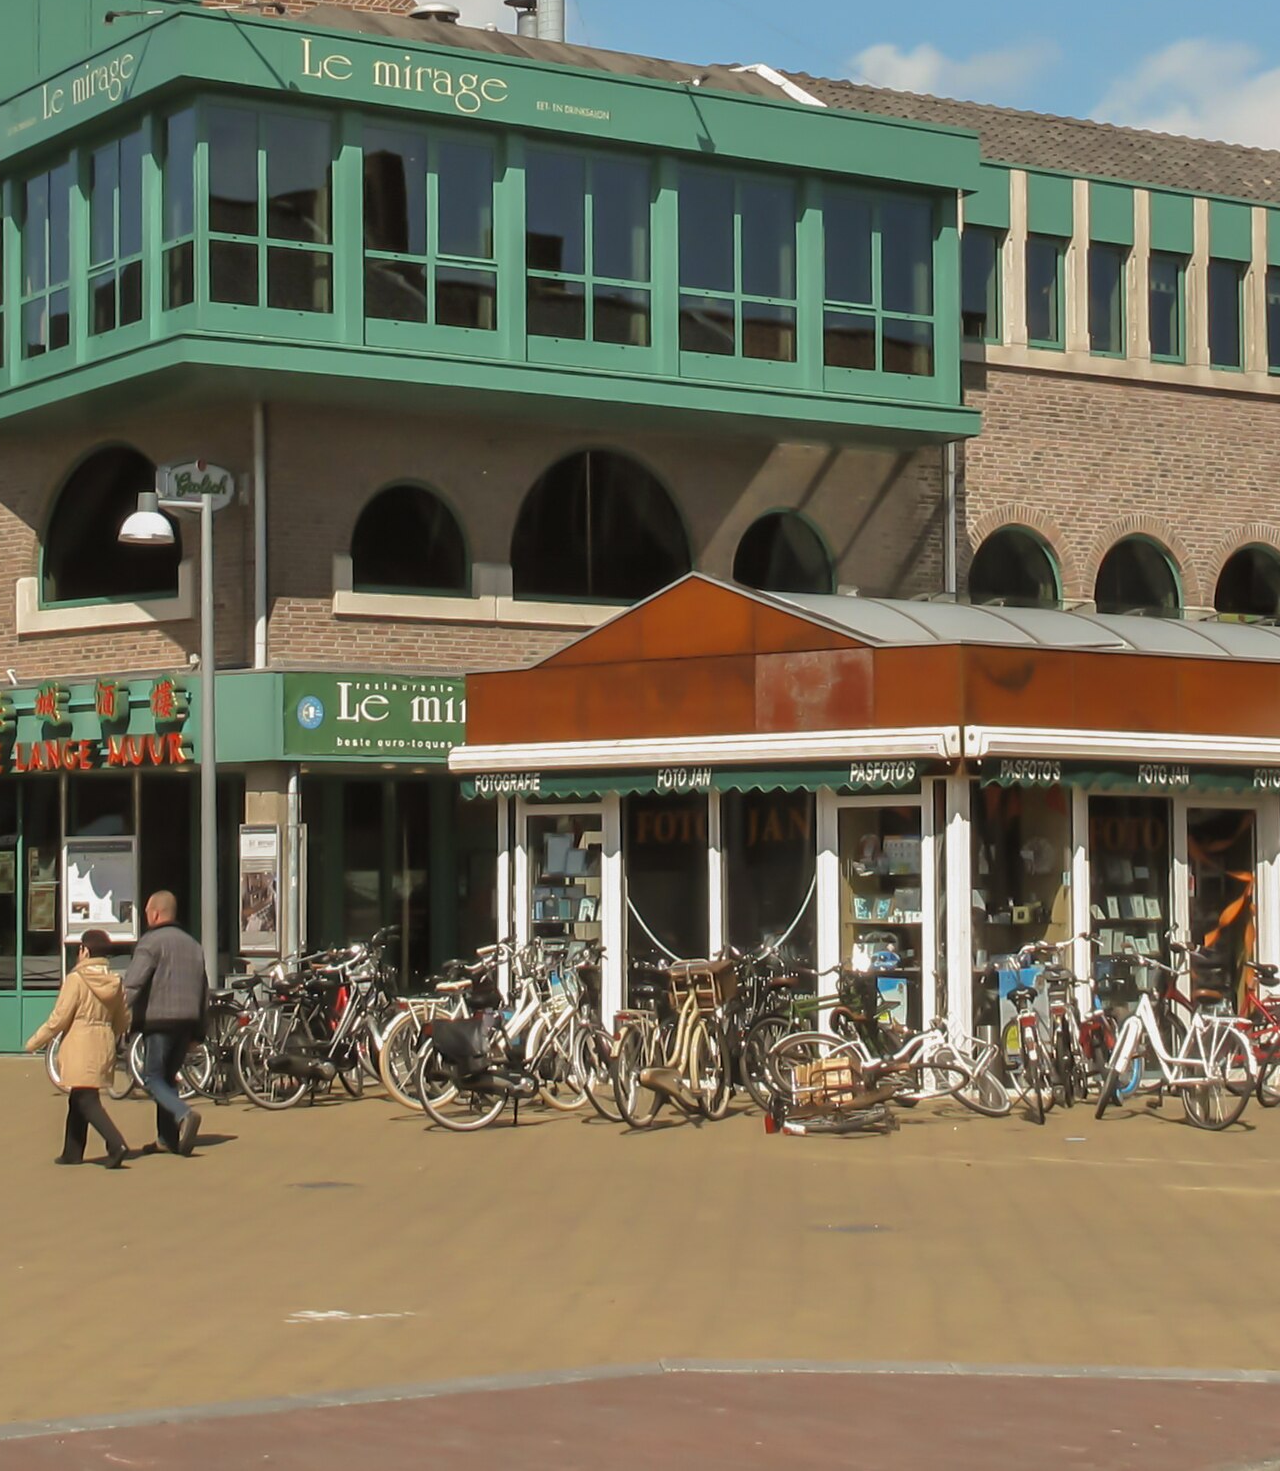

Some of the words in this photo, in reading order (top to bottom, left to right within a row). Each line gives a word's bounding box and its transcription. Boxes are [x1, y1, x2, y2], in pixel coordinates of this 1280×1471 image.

[301, 37, 353, 80] Le
[373, 55, 509, 113] mirage
[42, 83, 64, 120] Le
[72, 53, 134, 105] mirage
[336, 682, 390, 722] Le
[16, 738, 95, 771] LANGE
[107, 732, 187, 767] MUUR
[657, 768, 686, 788] FOTO
[688, 767, 712, 787] JAN
[850, 761, 916, 782] PASFOTO'S
[1000, 760, 1061, 780] PASFOTO'S
[1138, 765, 1167, 785] FOTO
[1169, 765, 1190, 785] JAN
[475, 773, 541, 793] FOTOGRAFIE
